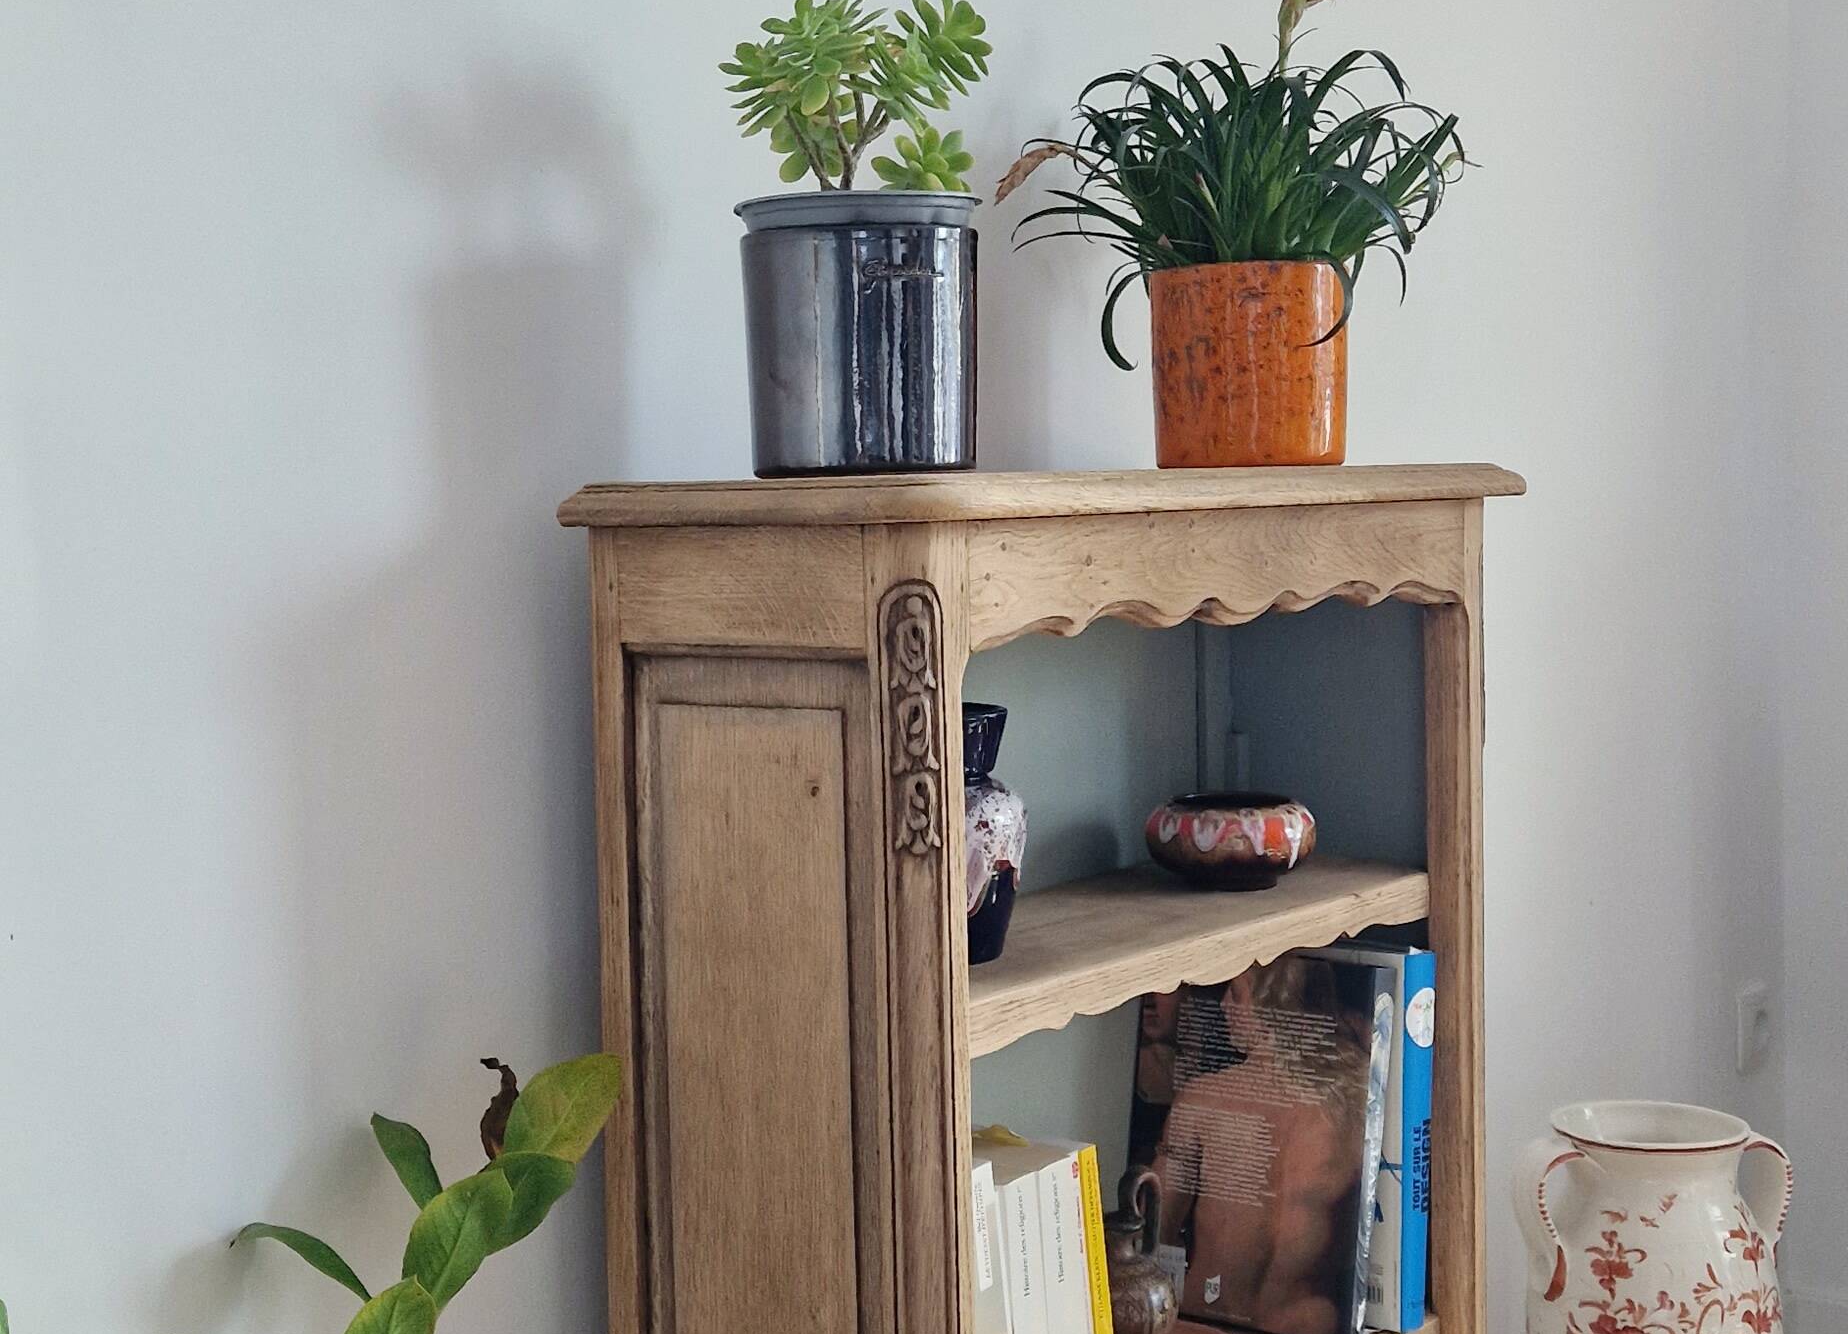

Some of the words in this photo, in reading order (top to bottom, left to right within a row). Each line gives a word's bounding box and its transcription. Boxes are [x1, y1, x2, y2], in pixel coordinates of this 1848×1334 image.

[1412, 1126, 1421, 1142] LE
[1412, 1147, 1421, 1174] SUR
[1420, 1118, 1431, 1213] DESIGN
[1412, 1178, 1420, 1211] TOUT
